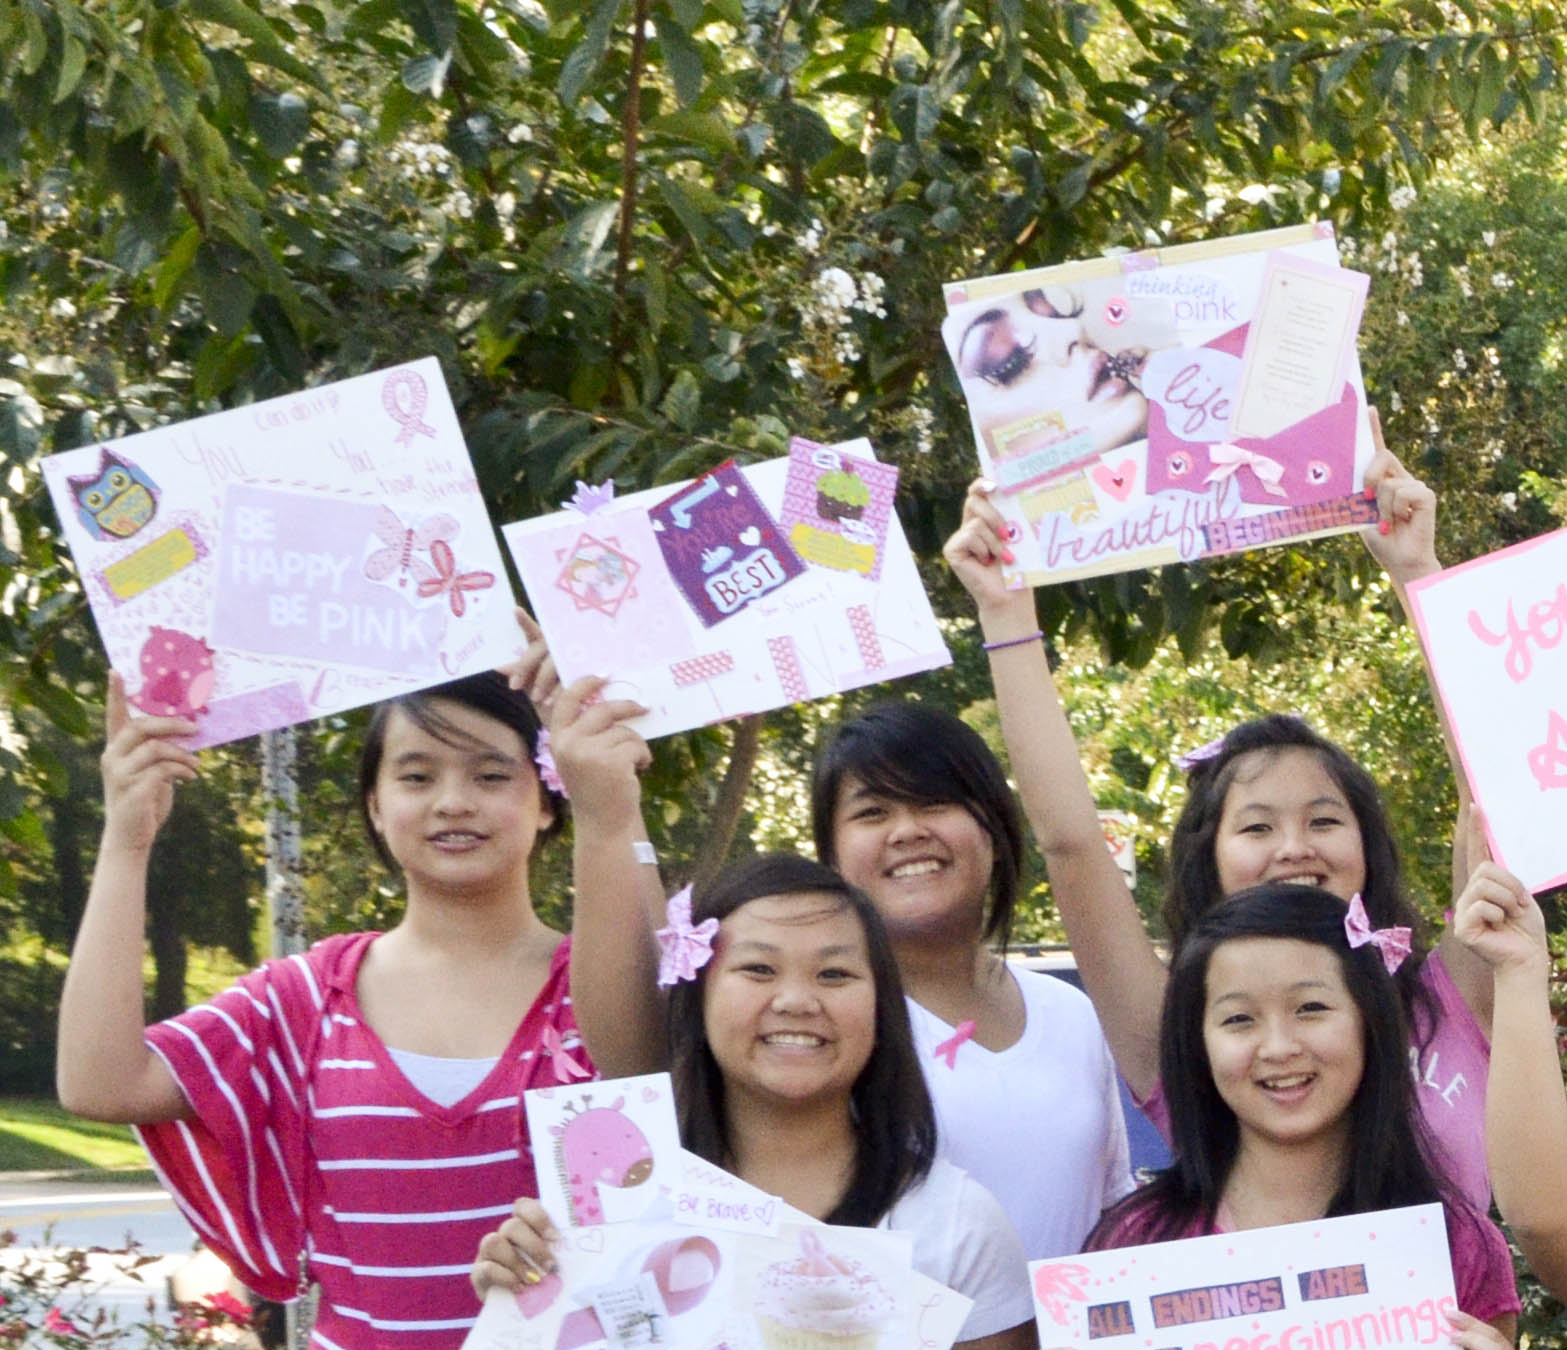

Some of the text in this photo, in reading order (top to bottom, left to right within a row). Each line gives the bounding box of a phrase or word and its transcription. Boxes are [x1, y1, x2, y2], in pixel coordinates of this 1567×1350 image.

[1129, 273, 1219, 299] thinking
[1174, 295, 1238, 324] pink
[1164, 363, 1230, 434] life
[236, 506, 277, 542] BE
[1047, 474, 1240, 567] beautiful
[232, 544, 353, 593] HAPPY
[713, 556, 780, 607] BEST
[269, 592, 428, 653] BE PINK
[1090, 1266, 1367, 1339] ALL ENDINGS ARE
